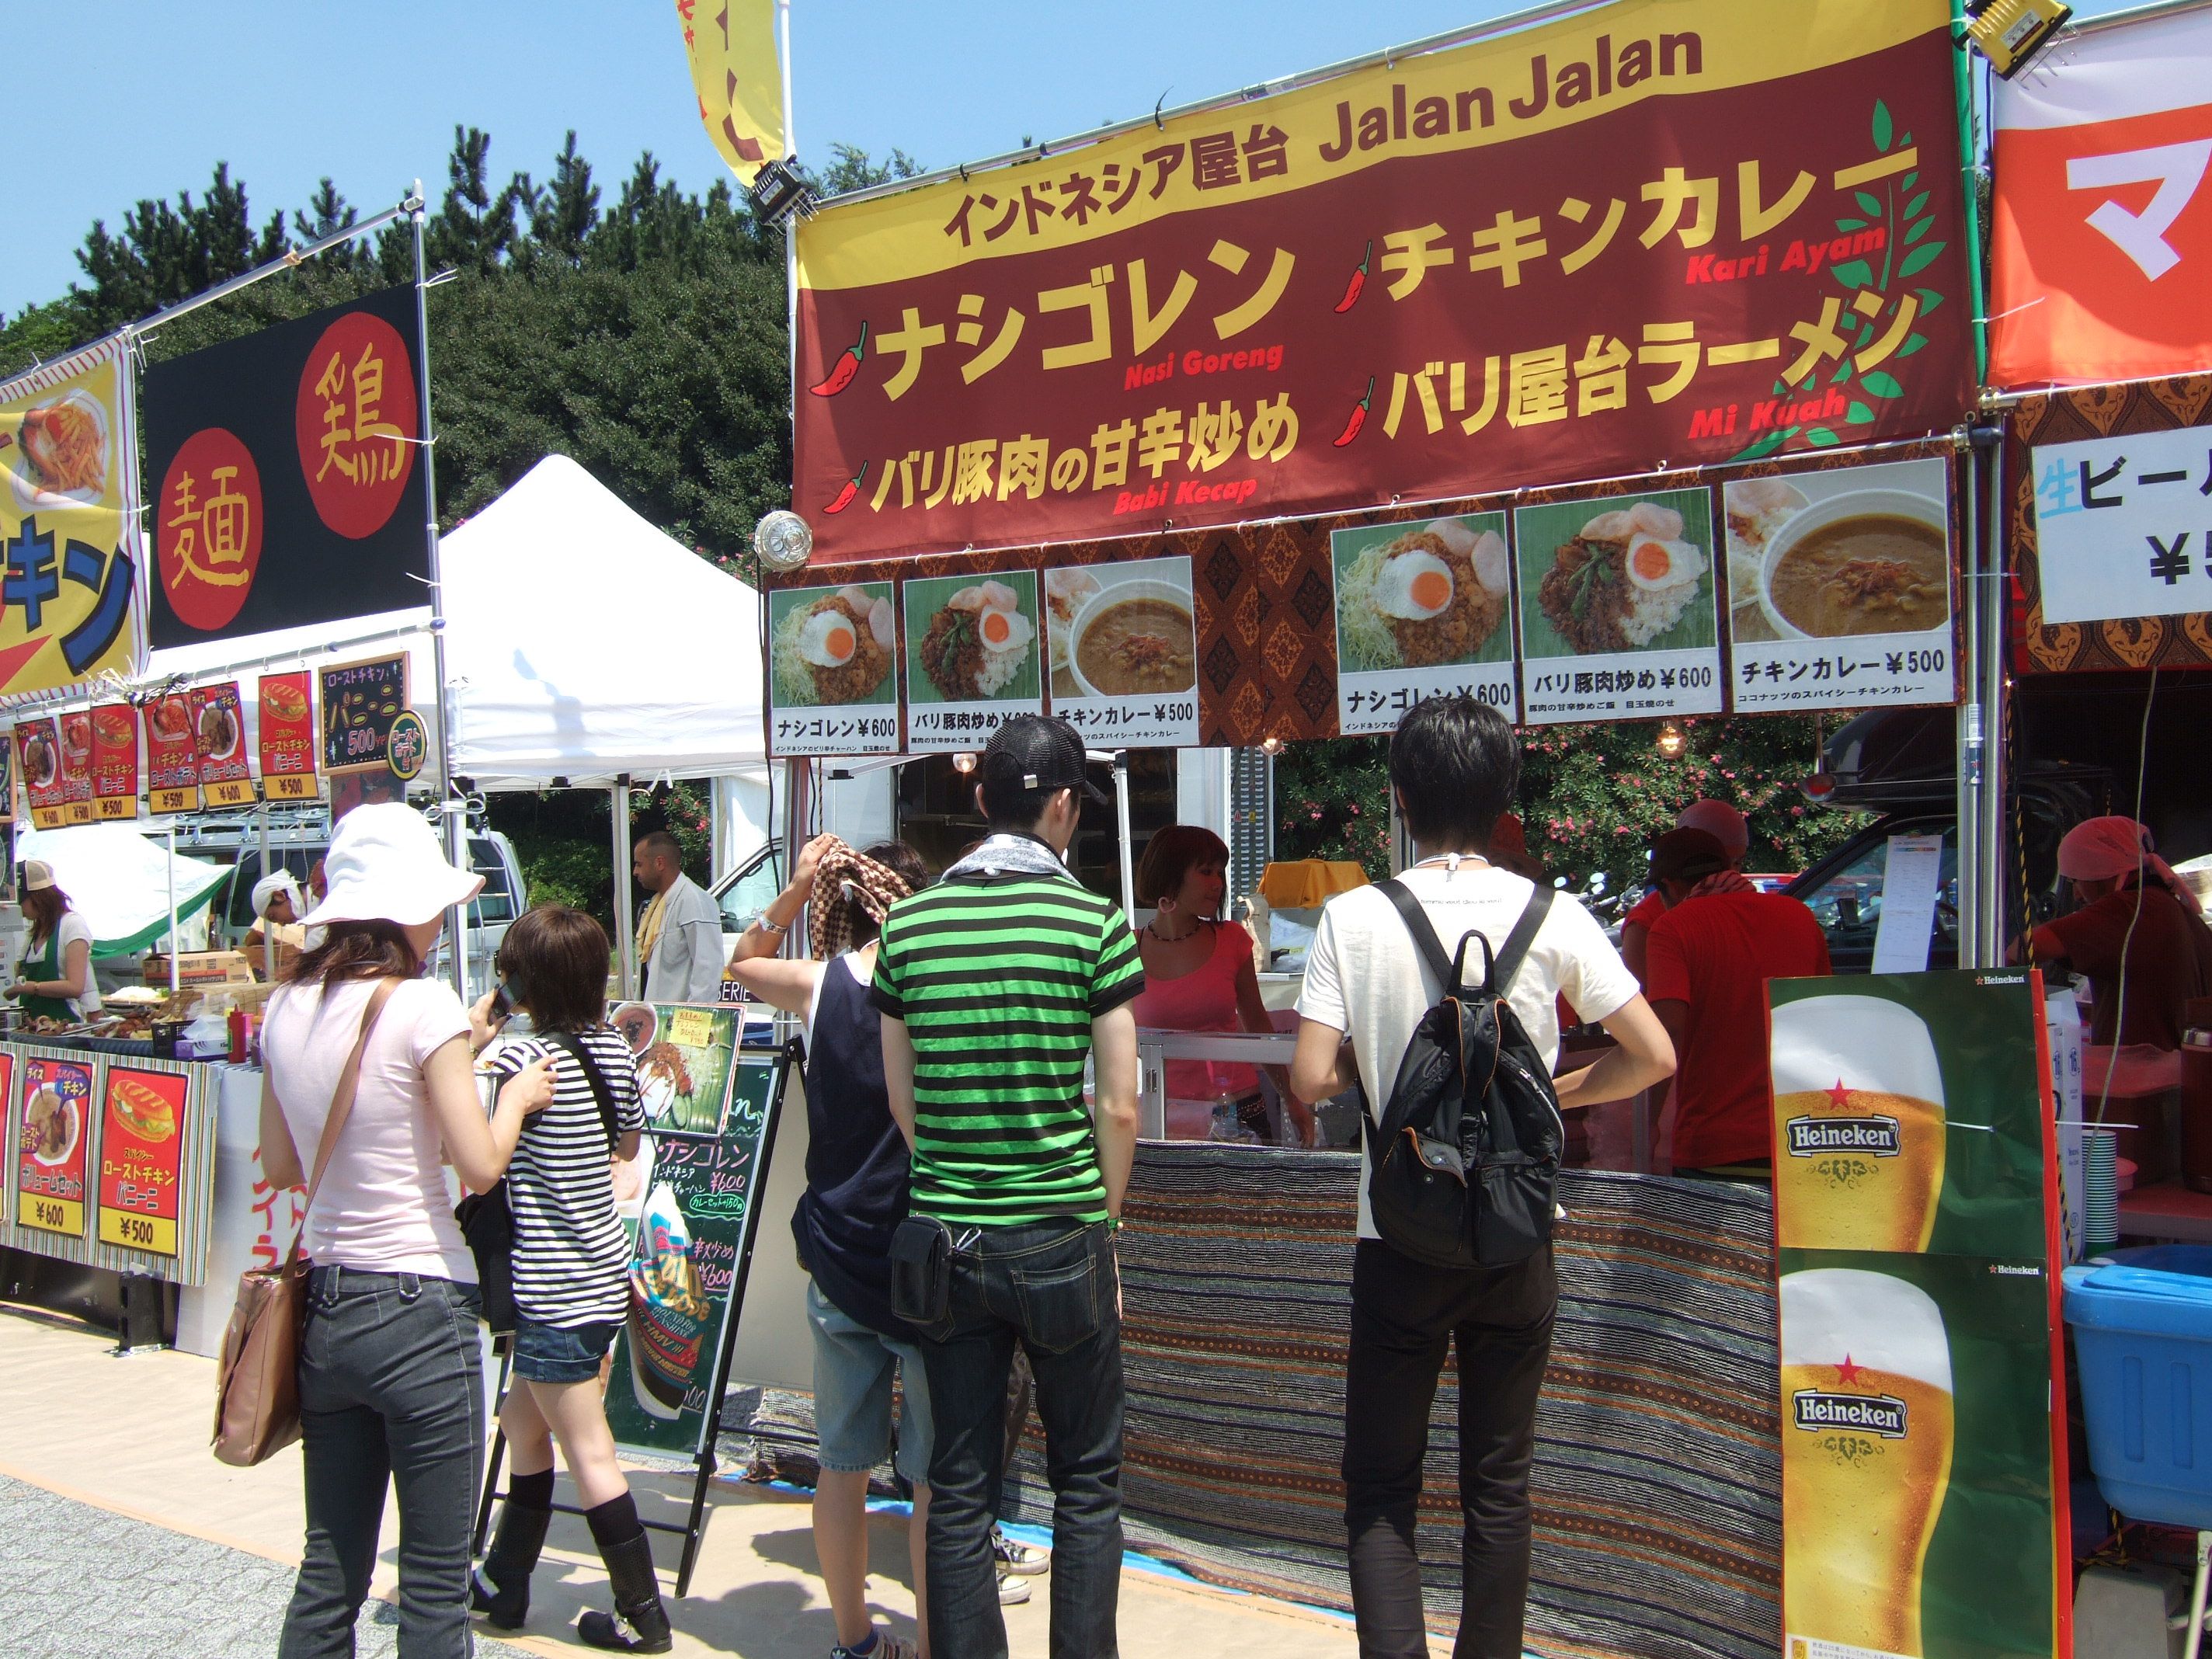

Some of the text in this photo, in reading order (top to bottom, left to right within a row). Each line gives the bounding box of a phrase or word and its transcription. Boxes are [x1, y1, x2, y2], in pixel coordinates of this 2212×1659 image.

[944, 31, 1702, 247] インドネシア屋台 Jalan Jalan
[1380, 147, 1918, 301] チキンカレー
[1685, 225, 1885, 284] Kari Ayam
[875, 238, 1296, 402] ナシゴレン
[1125, 344, 1283, 390] Nasi Goreng
[1382, 290, 1918, 440] バリ屋台ラーメン
[1688, 388, 1845, 440] Mi Kuah
[870, 392, 1299, 513] バリ豚肉の甘辛炒め
[1113, 478, 1257, 515] Babi Kecap
[0, 513, 136, 676] キン
[279, 779, 303, 795] ¥500
[103, 800, 122, 816] ¥500
[1984, 975, 2025, 985] Heineken
[27, 1067, 44, 1080] ライス
[63, 1080, 87, 1096] チキン
[1794, 1125, 1891, 1147] Heineken
[103, 1160, 175, 1186] ローストチキン
[117, 1181, 158, 1210] パニーニ
[36, 1201, 64, 1227] ¥600
[120, 1217, 153, 1244] ¥500
[1998, 1264, 2040, 1275] Heineken
[1800, 1399, 1899, 1428] Heineken
